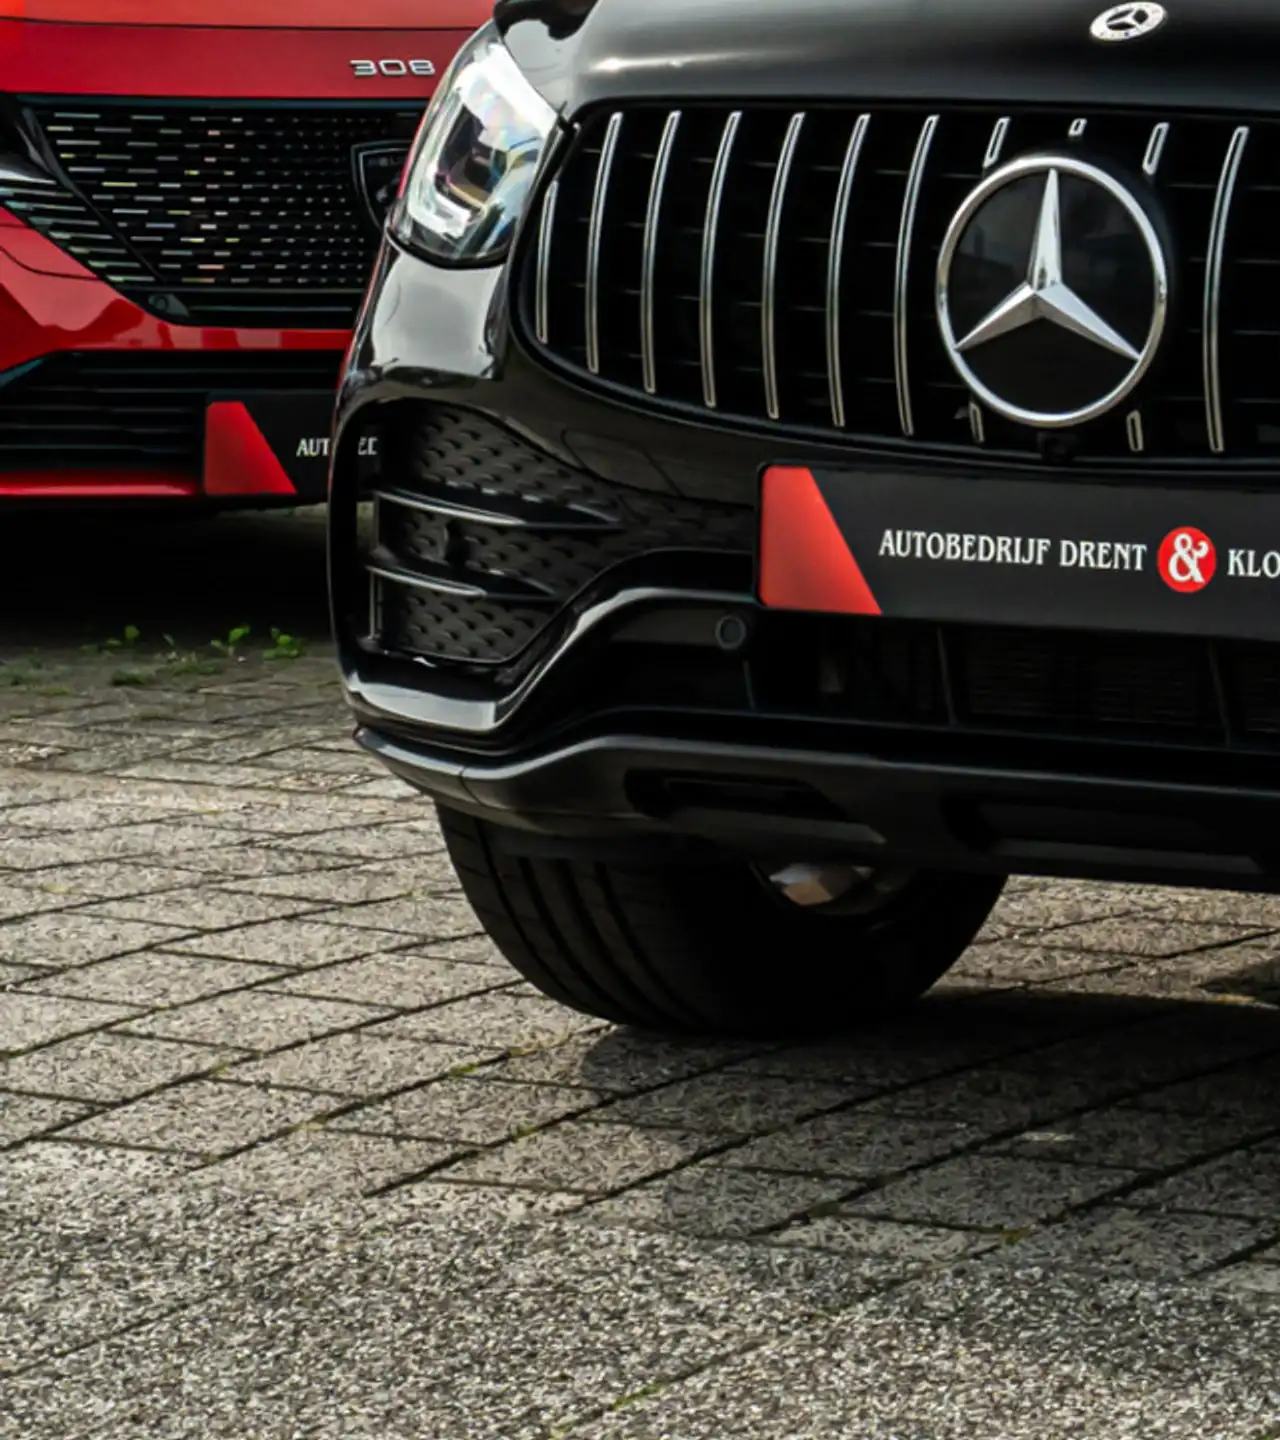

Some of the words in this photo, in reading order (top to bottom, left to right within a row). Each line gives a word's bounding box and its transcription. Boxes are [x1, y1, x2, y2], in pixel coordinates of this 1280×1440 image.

[349, 59, 436, 76] 308
[879, 529, 1052, 566] AUTOBEDRIJF
[1060, 540, 1147, 571] DRENT
[1168, 533, 1209, 583] &
